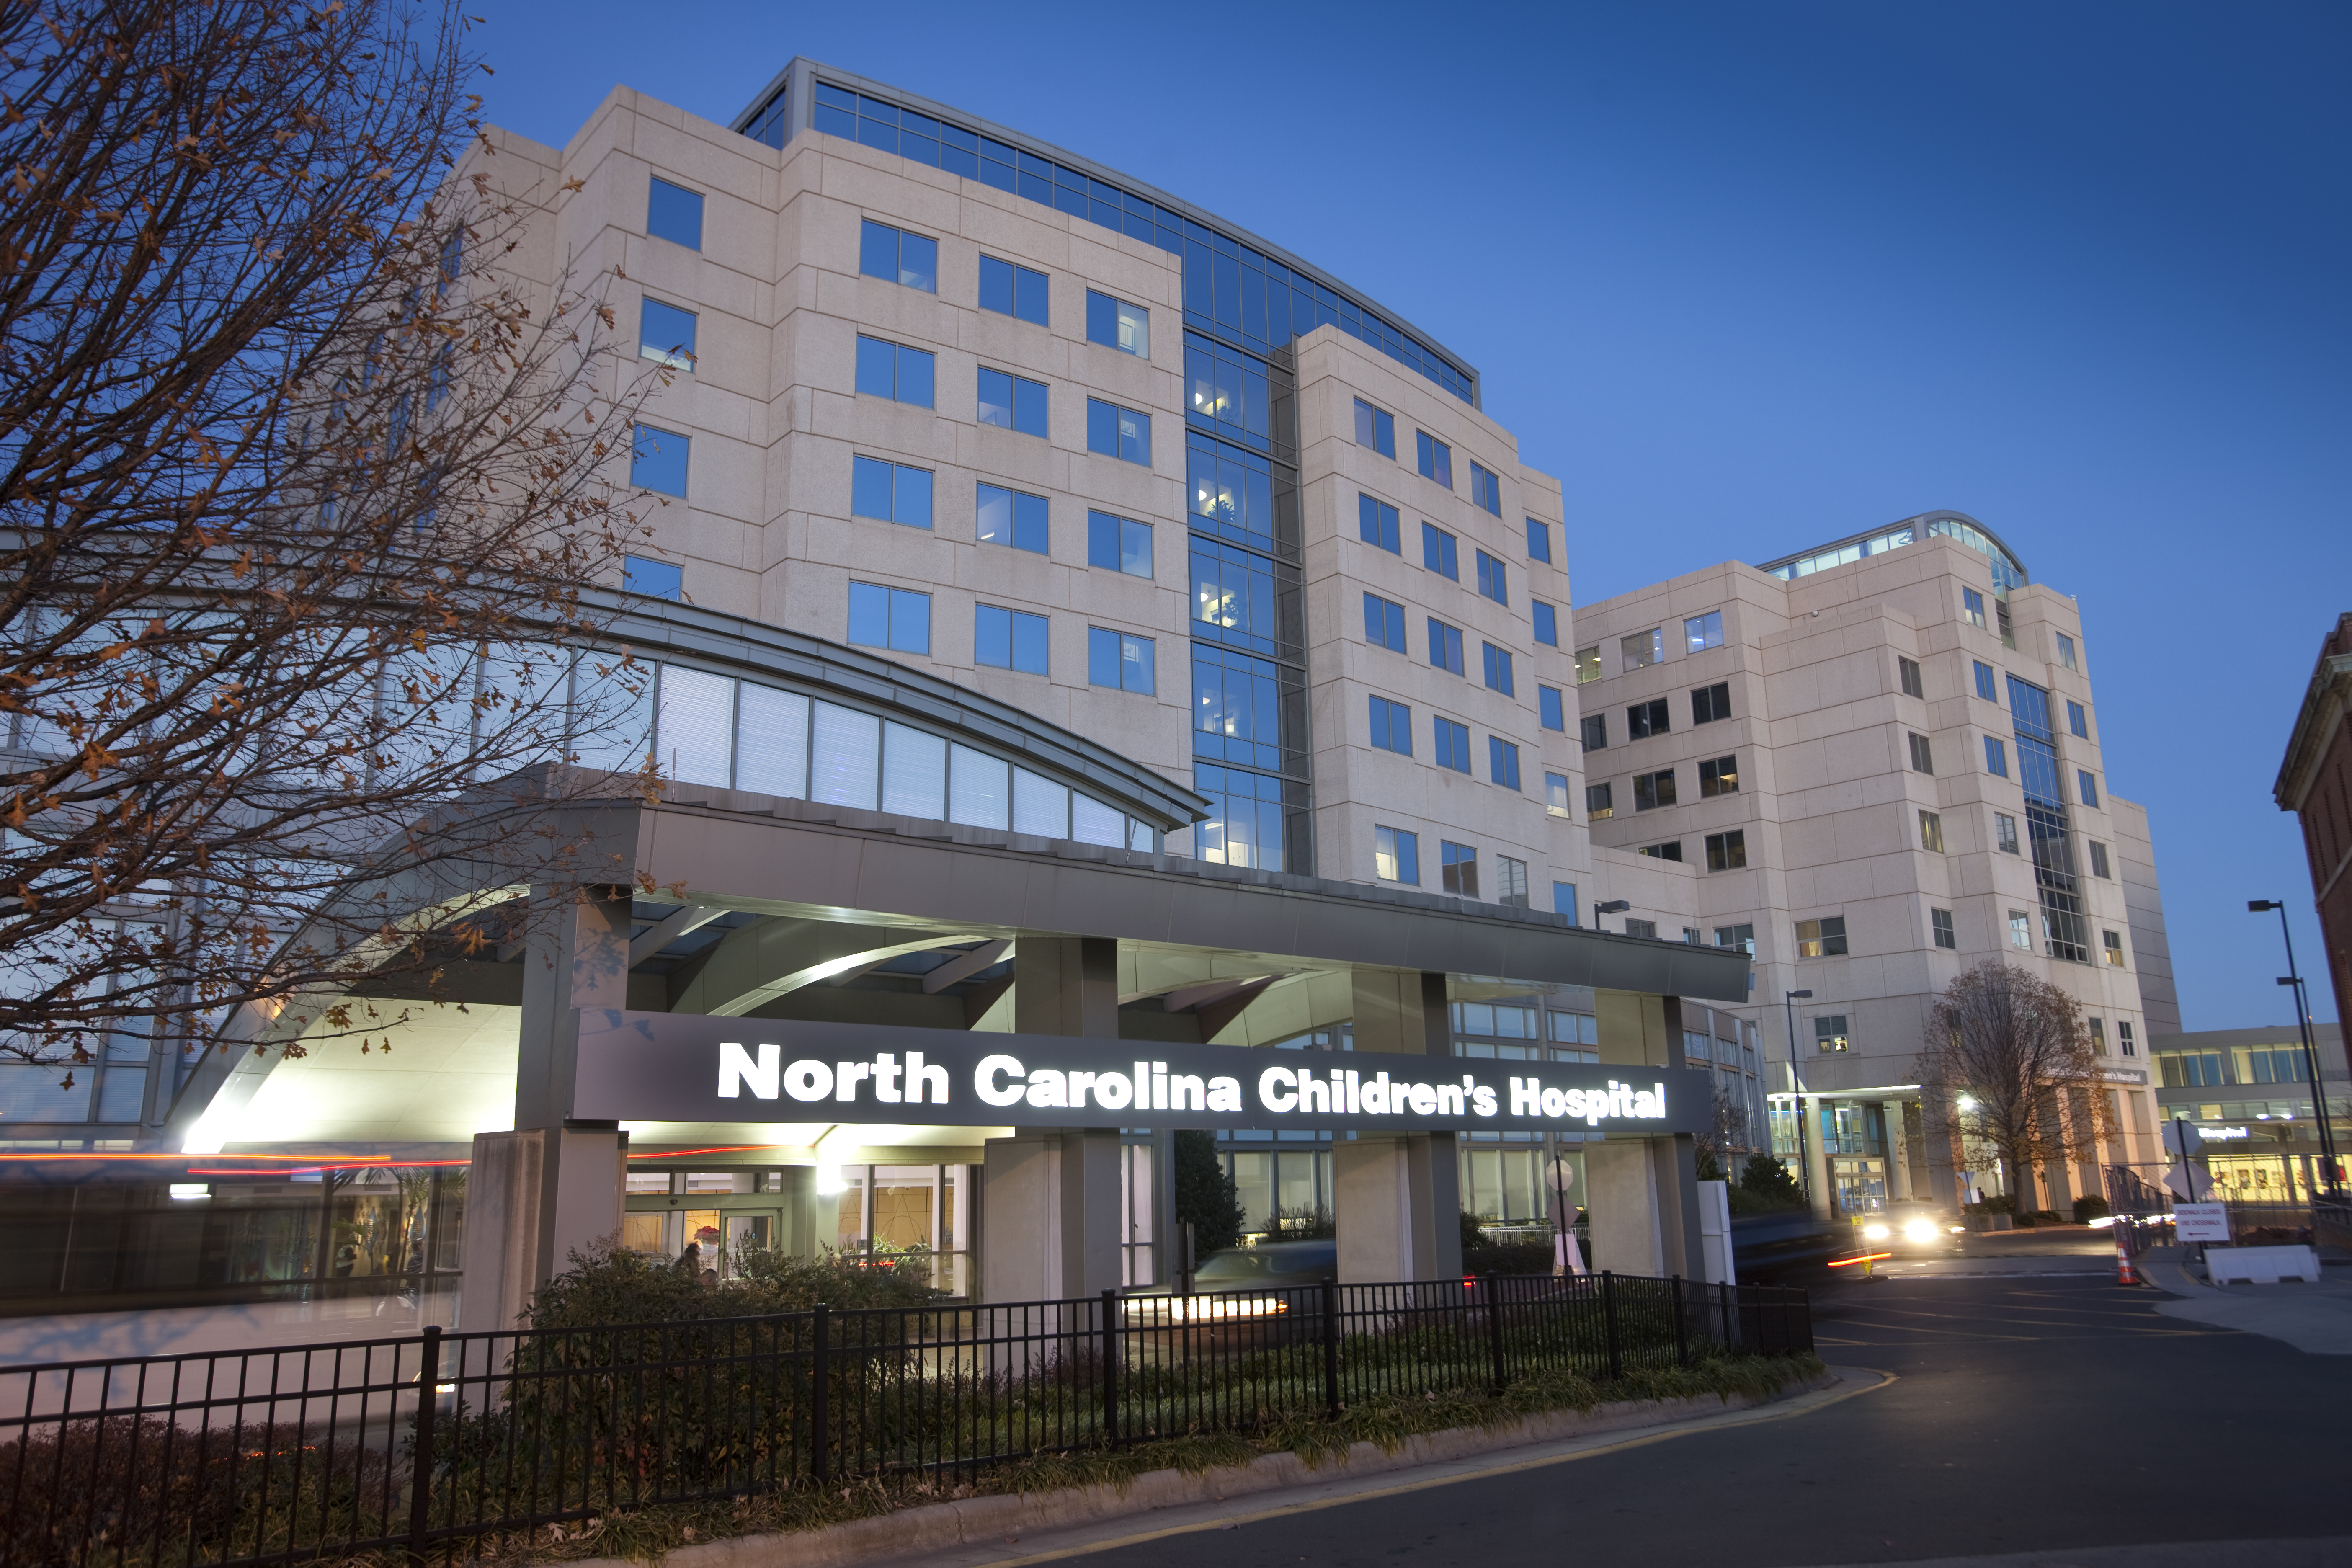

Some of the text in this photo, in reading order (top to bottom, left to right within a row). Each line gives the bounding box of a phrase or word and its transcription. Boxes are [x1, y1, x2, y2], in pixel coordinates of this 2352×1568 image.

[718, 1043, 1665, 1126] North Carolina Children's Hospital
[2117, 1071, 2141, 1083] Hospital
